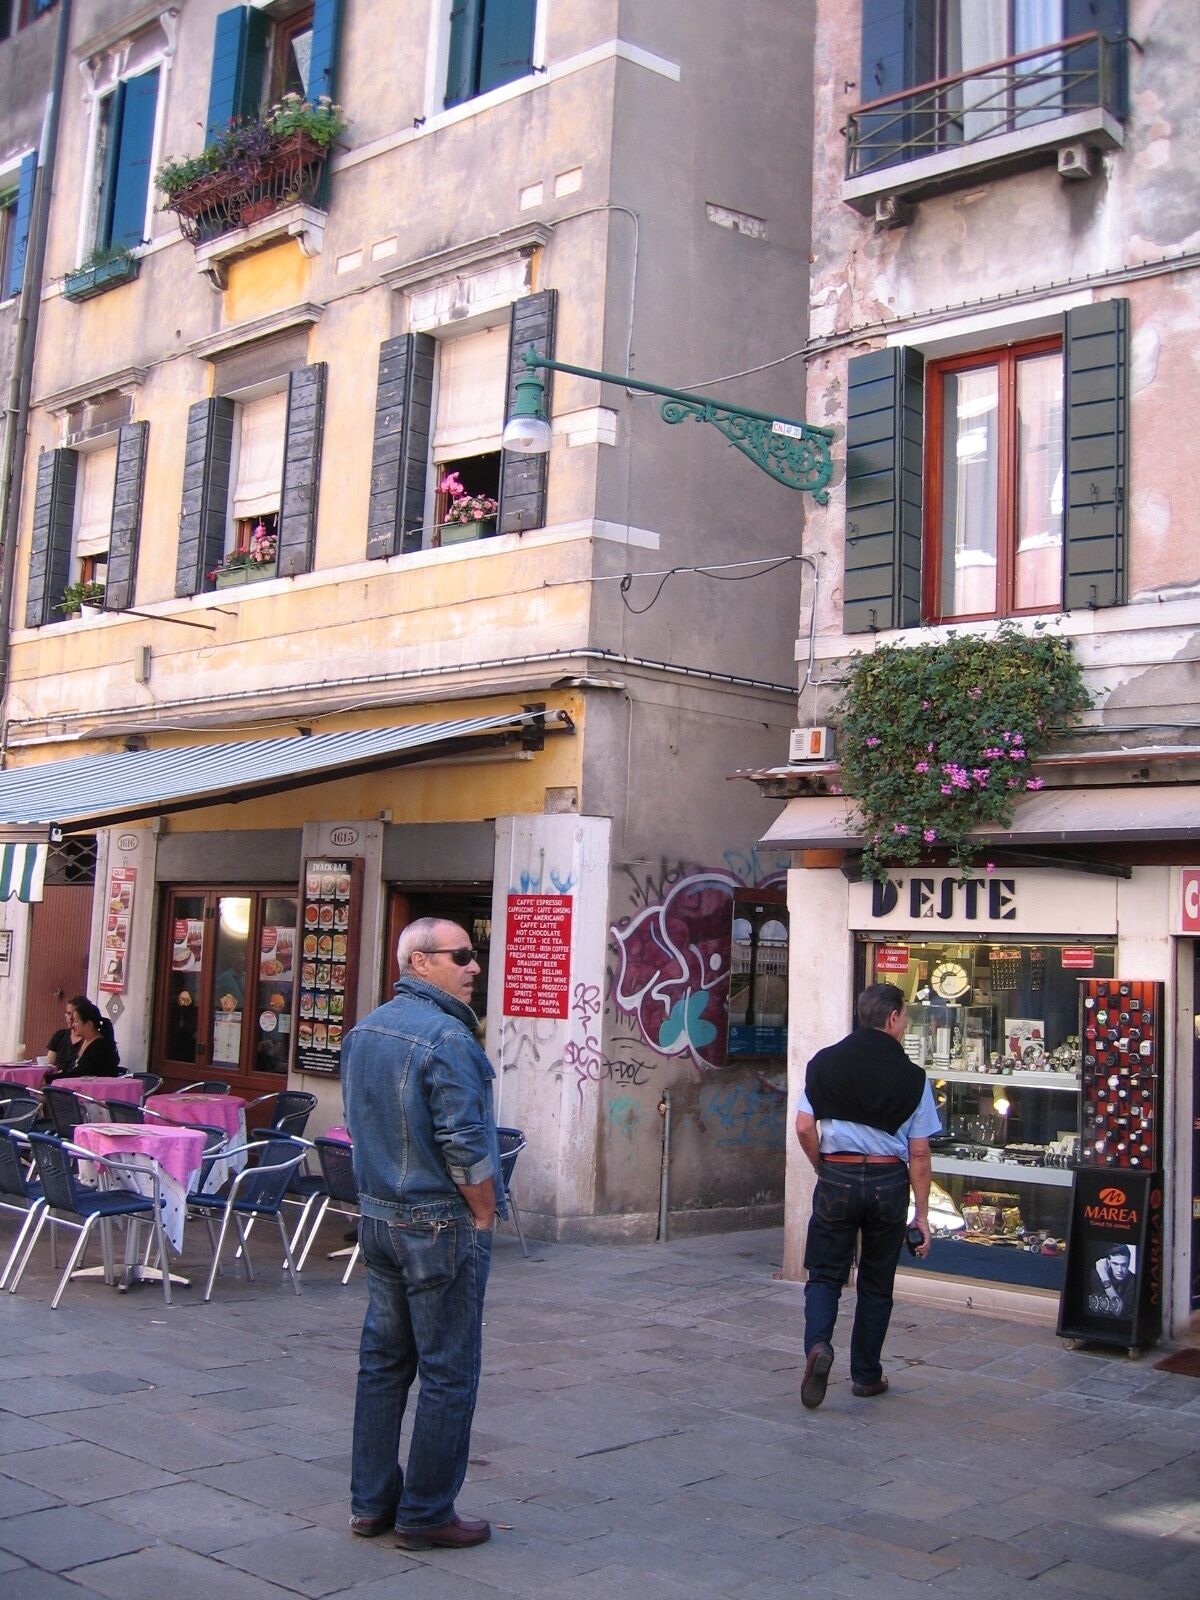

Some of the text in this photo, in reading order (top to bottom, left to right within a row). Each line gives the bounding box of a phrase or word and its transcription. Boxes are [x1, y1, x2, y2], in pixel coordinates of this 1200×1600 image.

[333, 832, 354, 843] 1615
[120, 839, 135, 848] 1616
[333, 863, 347, 872] BAR
[872, 877, 1017, 920] D'ESTE
[1084, 1205, 1137, 1223] MAREA
